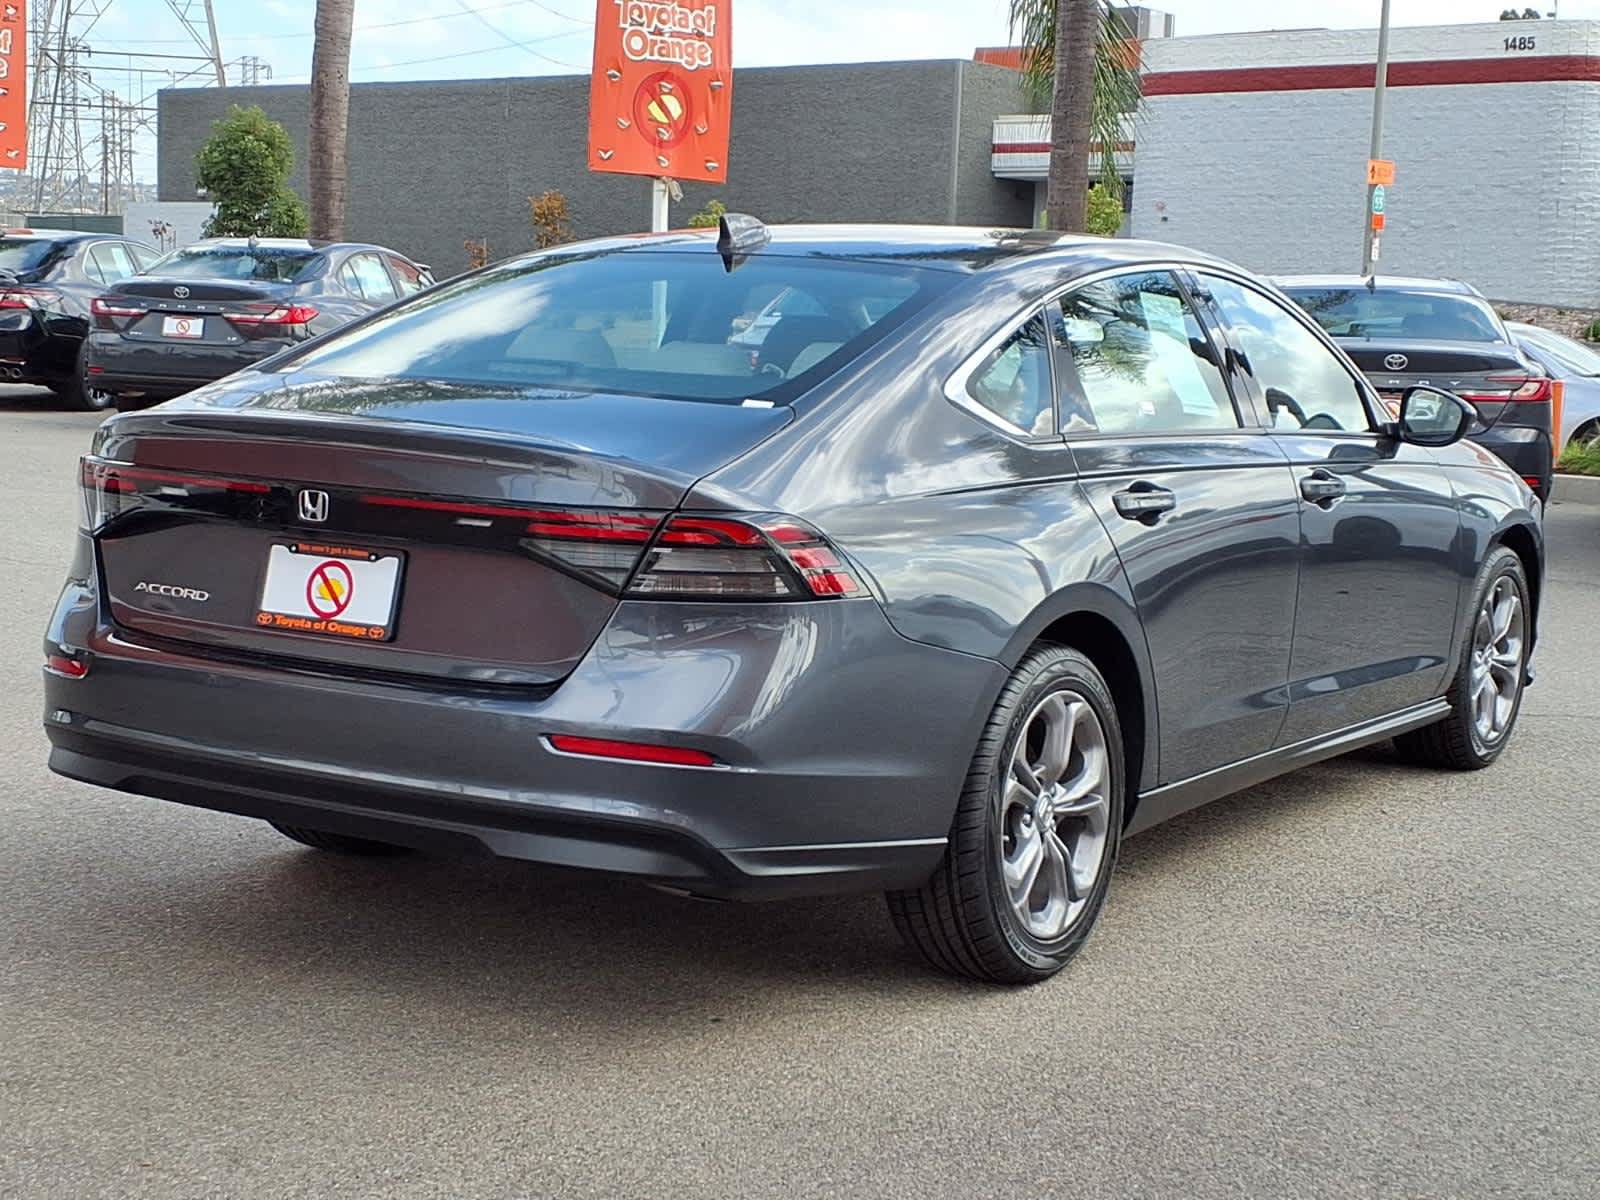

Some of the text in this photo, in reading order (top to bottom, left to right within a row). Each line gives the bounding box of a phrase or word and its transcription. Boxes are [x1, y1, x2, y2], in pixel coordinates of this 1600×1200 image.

[614, 0, 716, 36] Toyota of
[623, 26, 713, 71] Orange
[1504, 36, 1536, 51] 1485
[134, 582, 210, 601] ACCORD
[275, 614, 368, 637] Toyota of Orange
